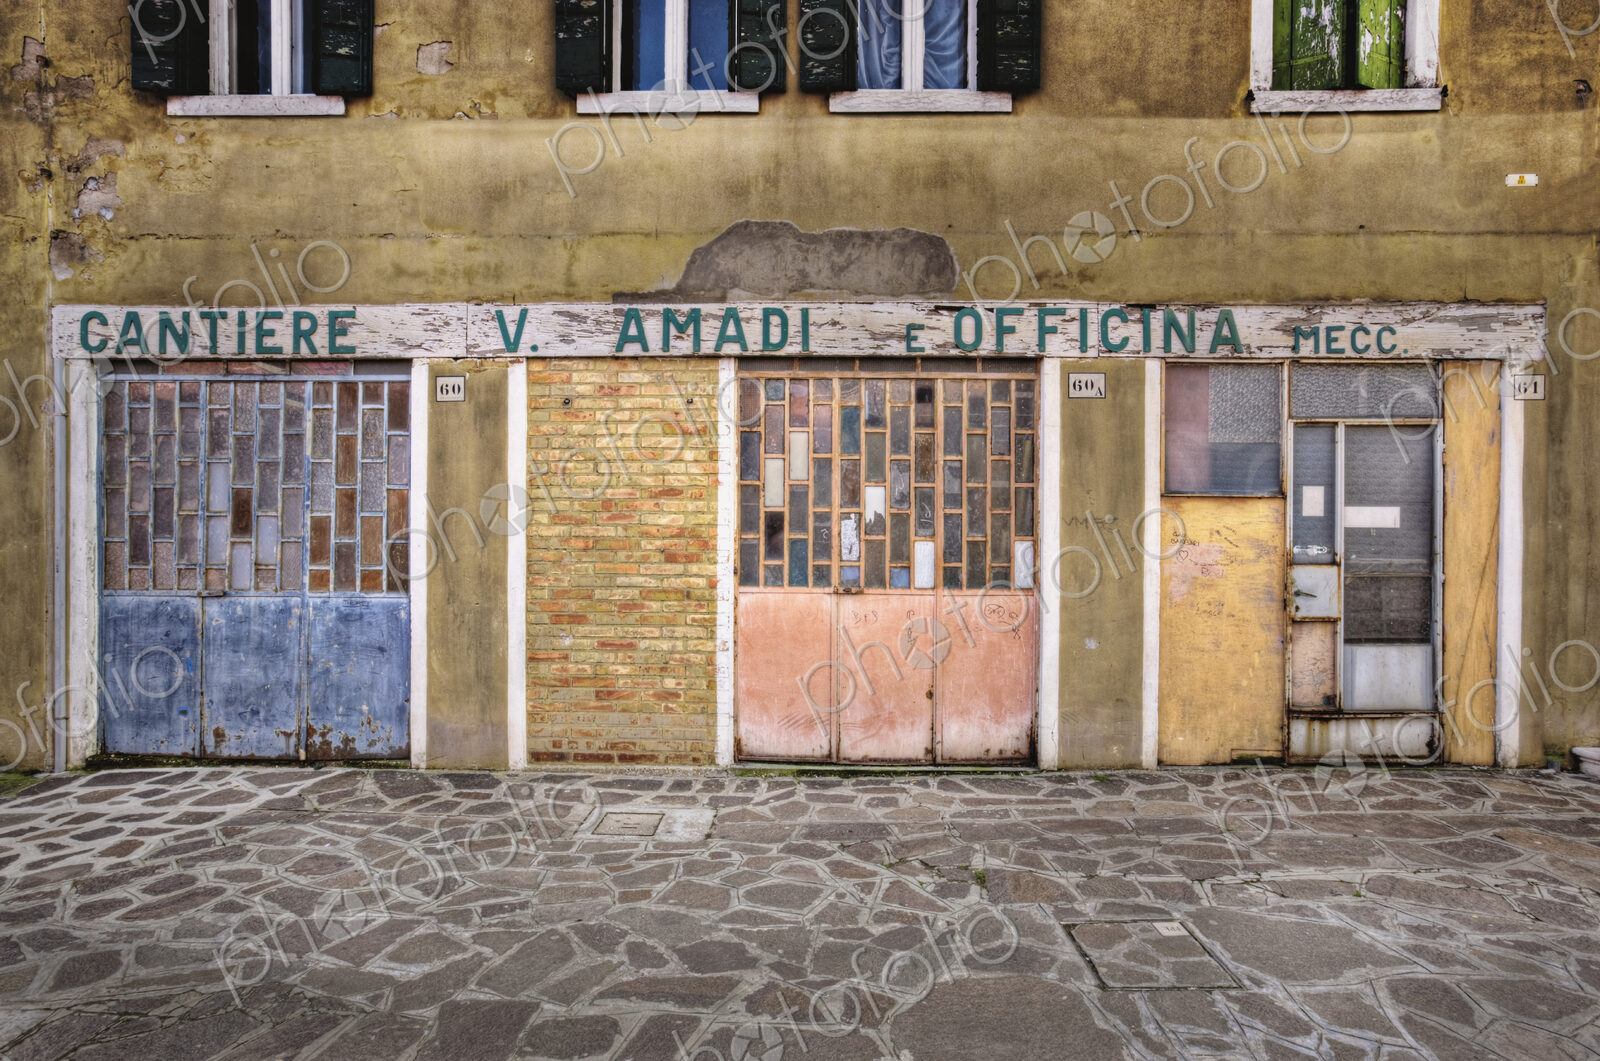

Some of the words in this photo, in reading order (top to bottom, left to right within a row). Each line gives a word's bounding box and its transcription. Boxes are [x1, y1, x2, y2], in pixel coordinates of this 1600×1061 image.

[79, 309, 356, 355] CANTIERE
[495, 308, 539, 353] V.
[615, 306, 810, 352] AMADI
[905, 323, 926, 352] E
[953, 307, 1244, 354] OFFICINA
[1294, 325, 1409, 355] MECC.
[440, 383, 461, 396] 60
[1517, 381, 1538, 394] 61
